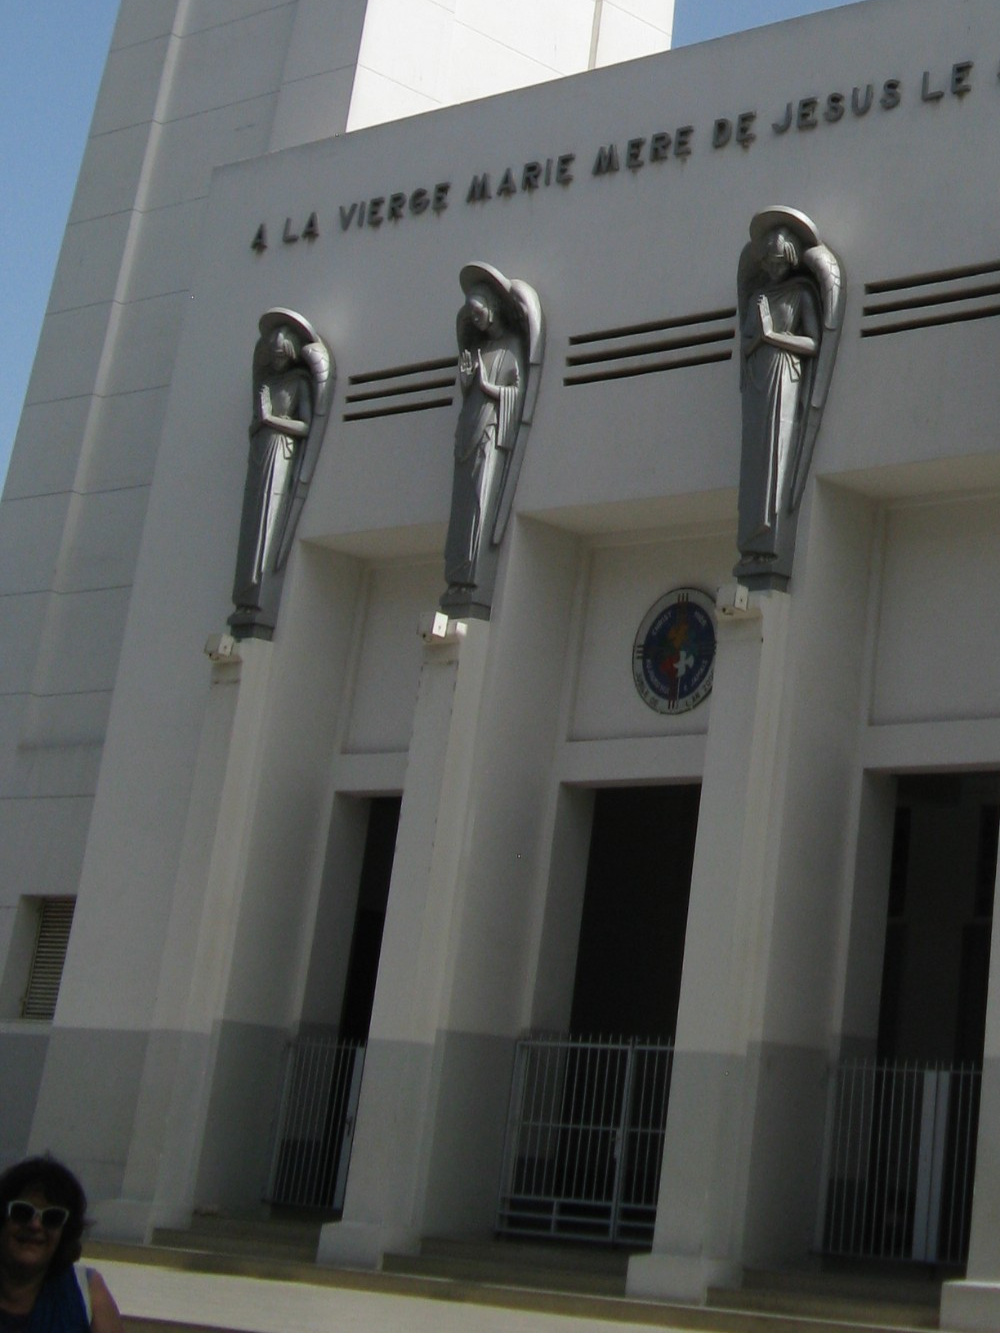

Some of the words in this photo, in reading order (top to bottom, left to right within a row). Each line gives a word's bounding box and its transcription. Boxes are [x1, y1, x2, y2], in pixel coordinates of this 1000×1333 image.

[251, 223, 267, 252] A
[283, 212, 319, 245] LA
[339, 181, 451, 232] VIERGE
[466, 153, 576, 204] MARIE
[592, 125, 694, 177] MERE
[713, 111, 757, 149] DE
[771, 78, 901, 135] JESUS
[922, 60, 973, 102] LE
